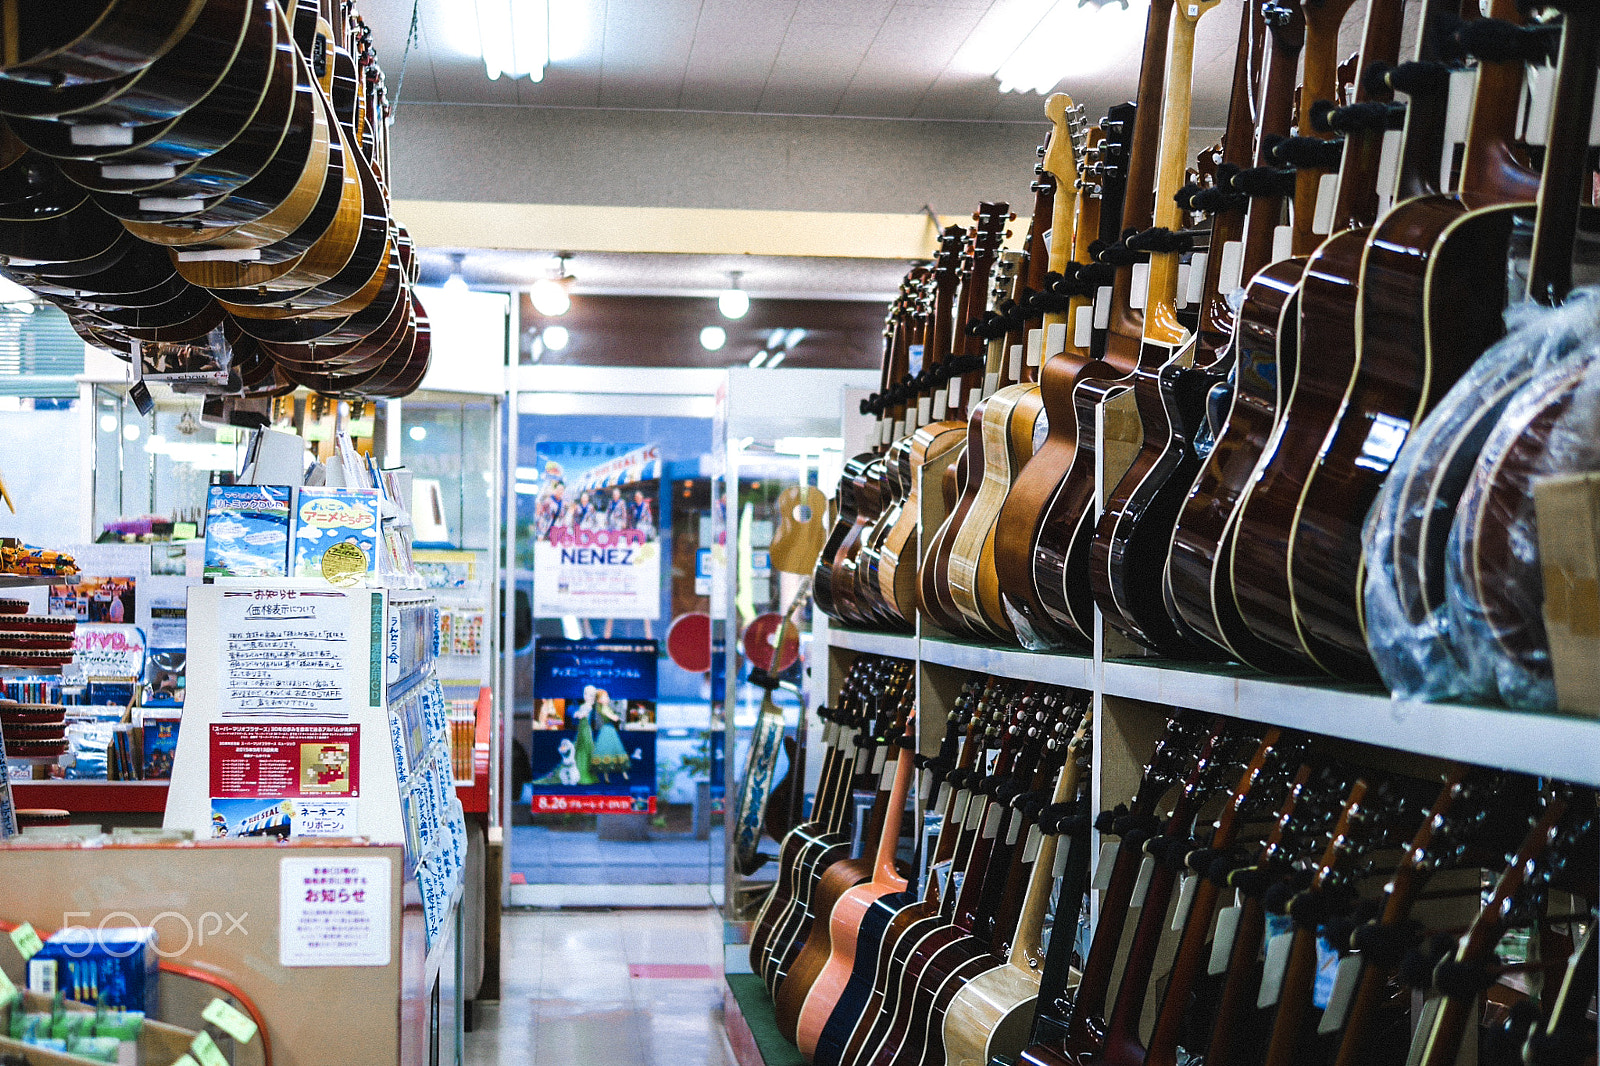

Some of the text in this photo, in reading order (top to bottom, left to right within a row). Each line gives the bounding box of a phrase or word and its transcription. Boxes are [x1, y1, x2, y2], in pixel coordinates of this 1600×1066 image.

[303, 511, 372, 525] アニメどうよう
[561, 548, 634, 566] NENEZ
[253, 589, 298, 601] お知らせ
[246, 603, 317, 616] 価格表示について
[387, 616, 400, 665] うんどう会
[538, 796, 568, 810] 8.26
[261, 806, 280, 820] SEAL
[300, 807, 346, 817] ネーネーズ
[305, 888, 366, 903] お知らせ
